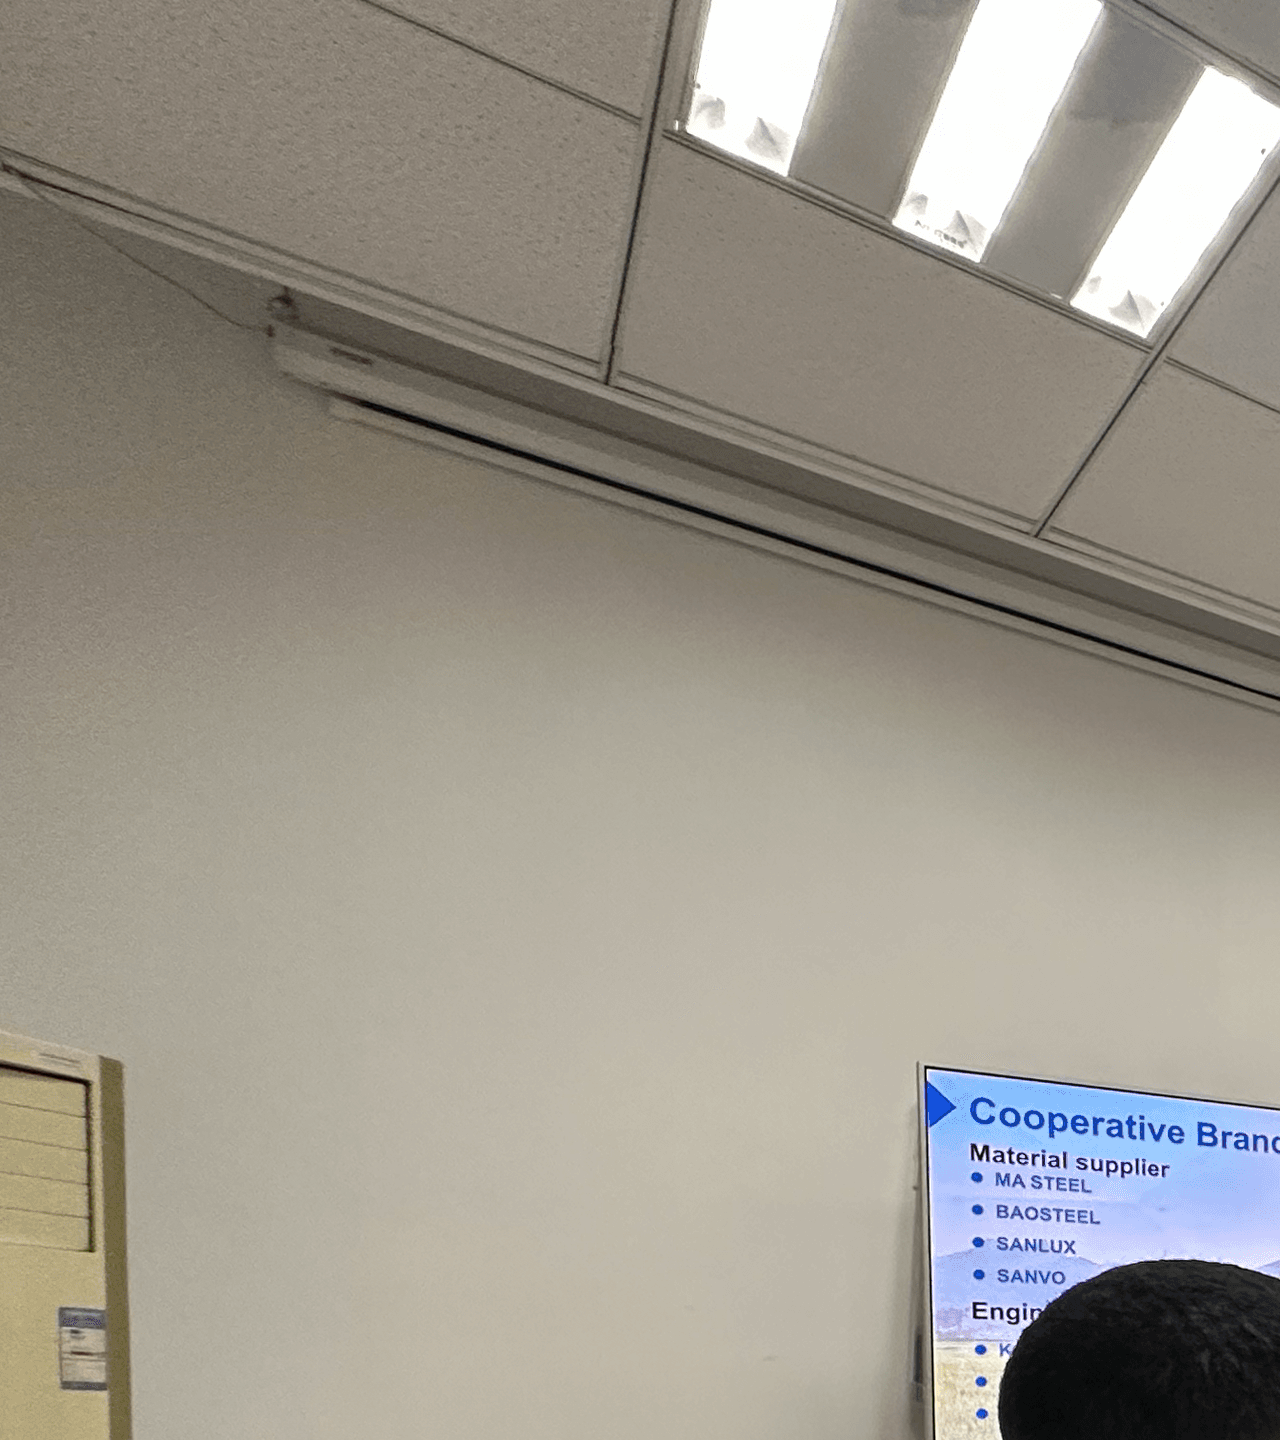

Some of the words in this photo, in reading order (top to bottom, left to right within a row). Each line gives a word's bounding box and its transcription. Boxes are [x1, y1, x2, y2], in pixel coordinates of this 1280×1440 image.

[969, 1096, 1185, 1144] Cooperative
[970, 1143, 1068, 1169] Material
[1076, 1153, 1170, 1178] supplier
[995, 1172, 1026, 1189] MA
[1030, 1175, 1093, 1194] STEEL
[996, 1204, 1101, 1225] BAOSTEEL
[997, 1237, 1076, 1255] SANLUX
[997, 1269, 1066, 1285] SANVO
